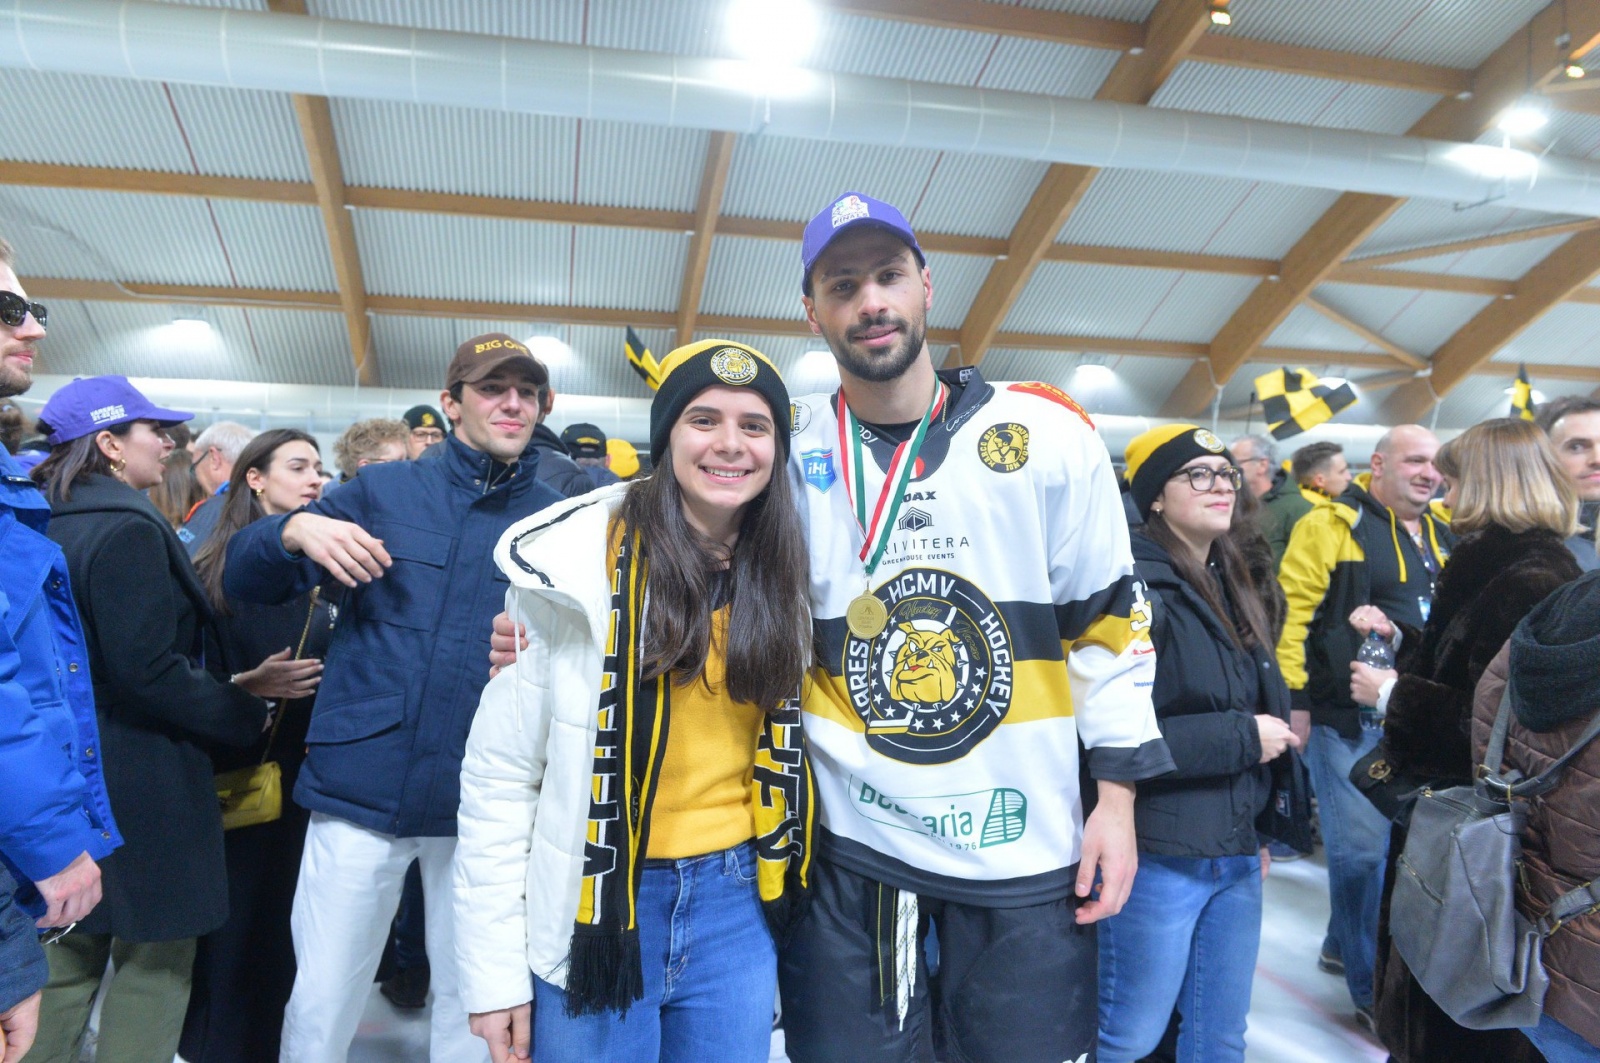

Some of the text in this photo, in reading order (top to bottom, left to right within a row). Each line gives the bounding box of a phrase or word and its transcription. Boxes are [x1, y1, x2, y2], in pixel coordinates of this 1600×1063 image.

[474, 339, 502, 354] BIG
[1007, 423, 1029, 443] SEMPRE
[980, 441, 996, 468] MARCO
[884, 536, 970, 555] RIVITERA
[882, 552, 955, 566] GREENHOUSE EVENTS
[888, 572, 955, 604] HCMV
[980, 612, 1011, 718] HOCKEY
